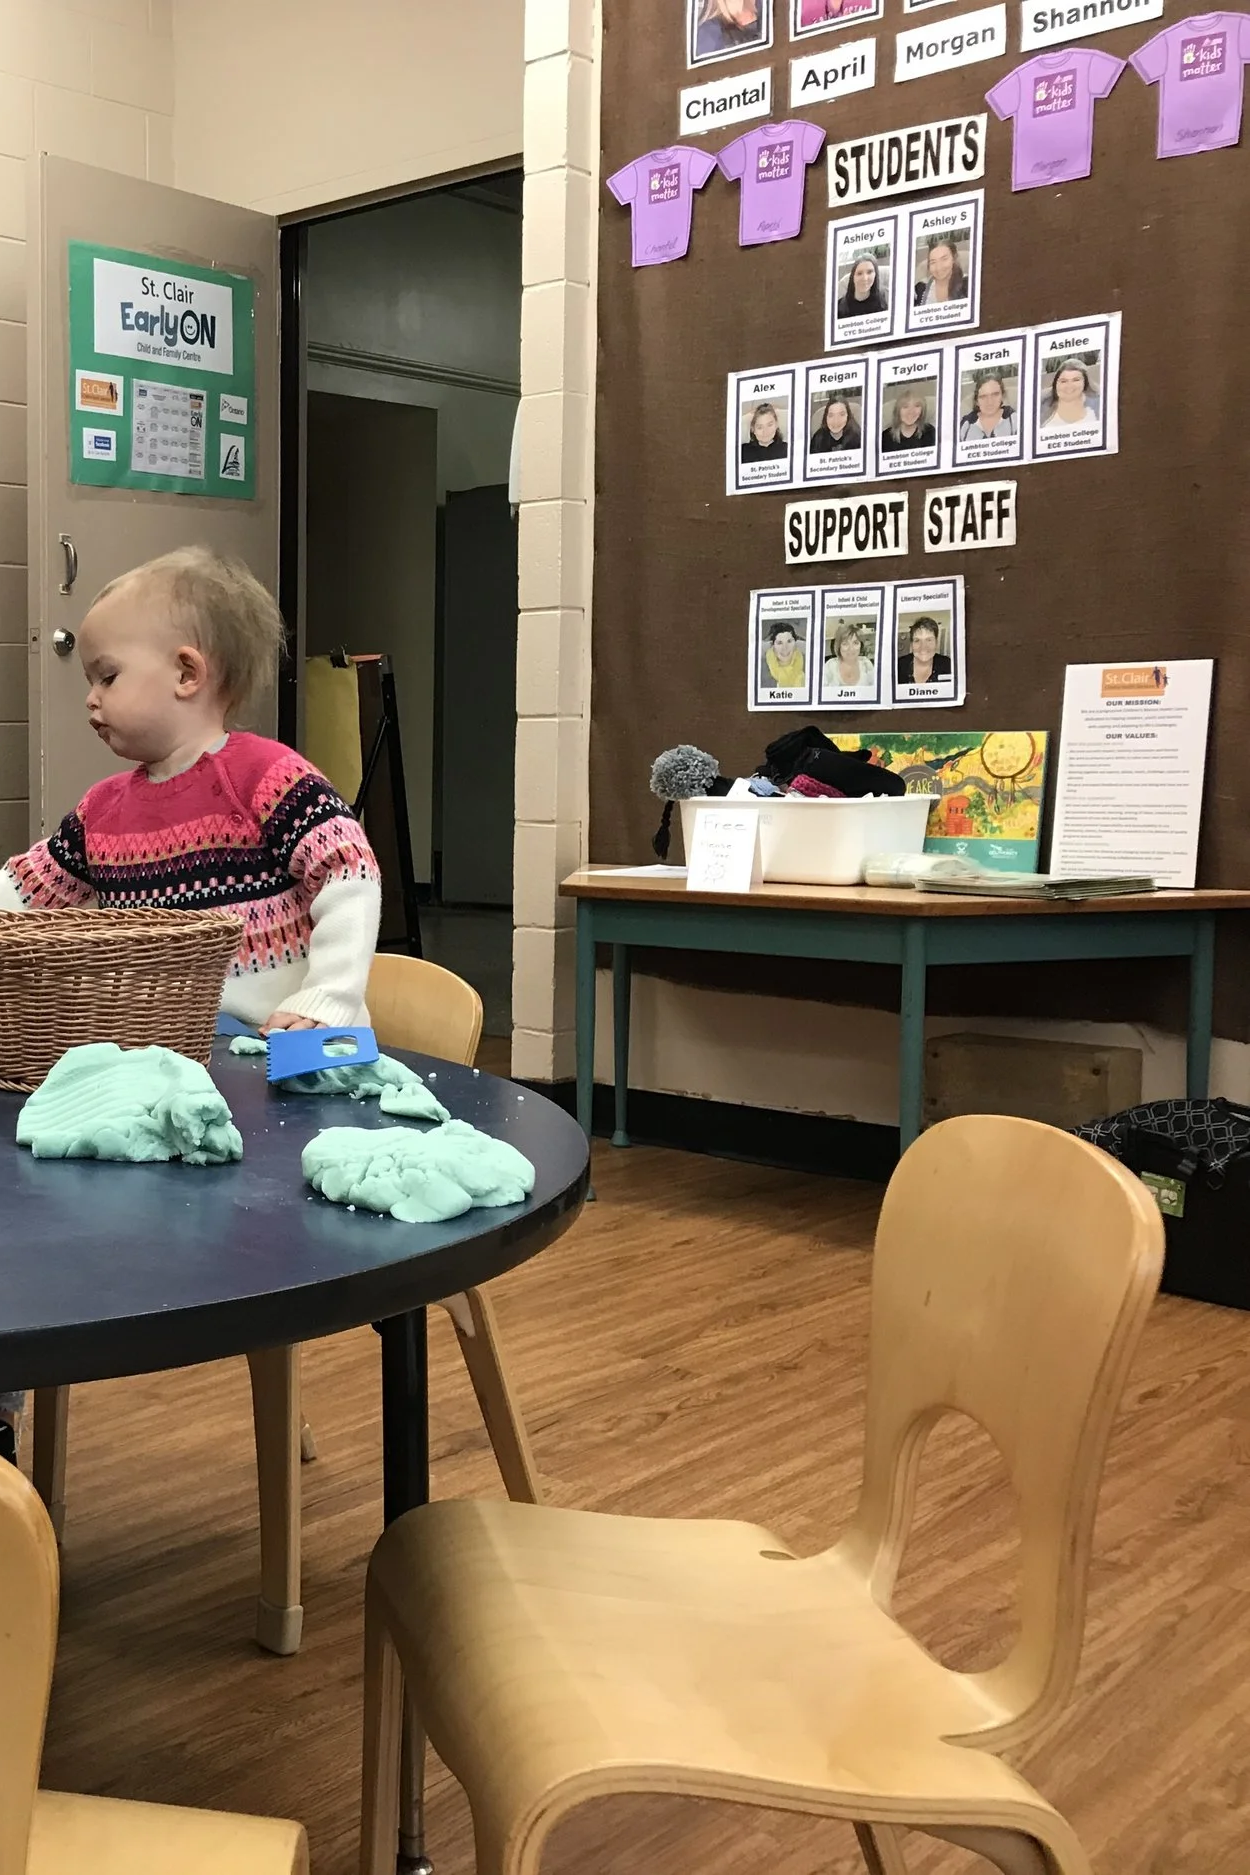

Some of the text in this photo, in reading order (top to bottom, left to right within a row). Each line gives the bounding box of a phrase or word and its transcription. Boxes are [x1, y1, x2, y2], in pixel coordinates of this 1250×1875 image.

[906, 25, 996, 64] Morgan
[1199, 45, 1222, 61] kids
[801, 55, 865, 91] April
[1182, 61, 1222, 77] matter
[1051, 82, 1073, 98] kids
[686, 82, 766, 119] Chantal
[1036, 97, 1073, 113] matter
[772, 151, 789, 166] kids
[835, 120, 979, 198] STUDENTS
[758, 166, 789, 180] matter
[663, 175, 678, 190] kids
[651, 188, 678, 202] matter
[922, 211, 967, 229] Ashley S
[843, 228, 885, 245] Ashley G
[141, 277, 194, 304] St. Clair
[943, 302, 968, 312] College
[935, 312, 961, 321] Student
[120, 302, 216, 349] EarlyON
[1050, 337, 1090, 351] Ashlee
[137, 342, 201, 362] Child and Family Centre
[974, 348, 1010, 362] Sarah
[892, 362, 929, 376] Taylor
[819, 370, 858, 384] Reigan
[753, 383, 775, 394] Alex
[1040, 429, 1099, 442] Lambton College
[1064, 438, 1091, 447] Student
[991, 439, 1017, 448] College
[911, 450, 934, 458] College
[982, 449, 1009, 458] Student
[789, 489, 1011, 557] SUPPORT STAFF
[769, 690, 793, 699] Katie
[908, 688, 938, 696] Diane
[916, 778, 933, 794] ARE
[704, 814, 747, 833] Free
